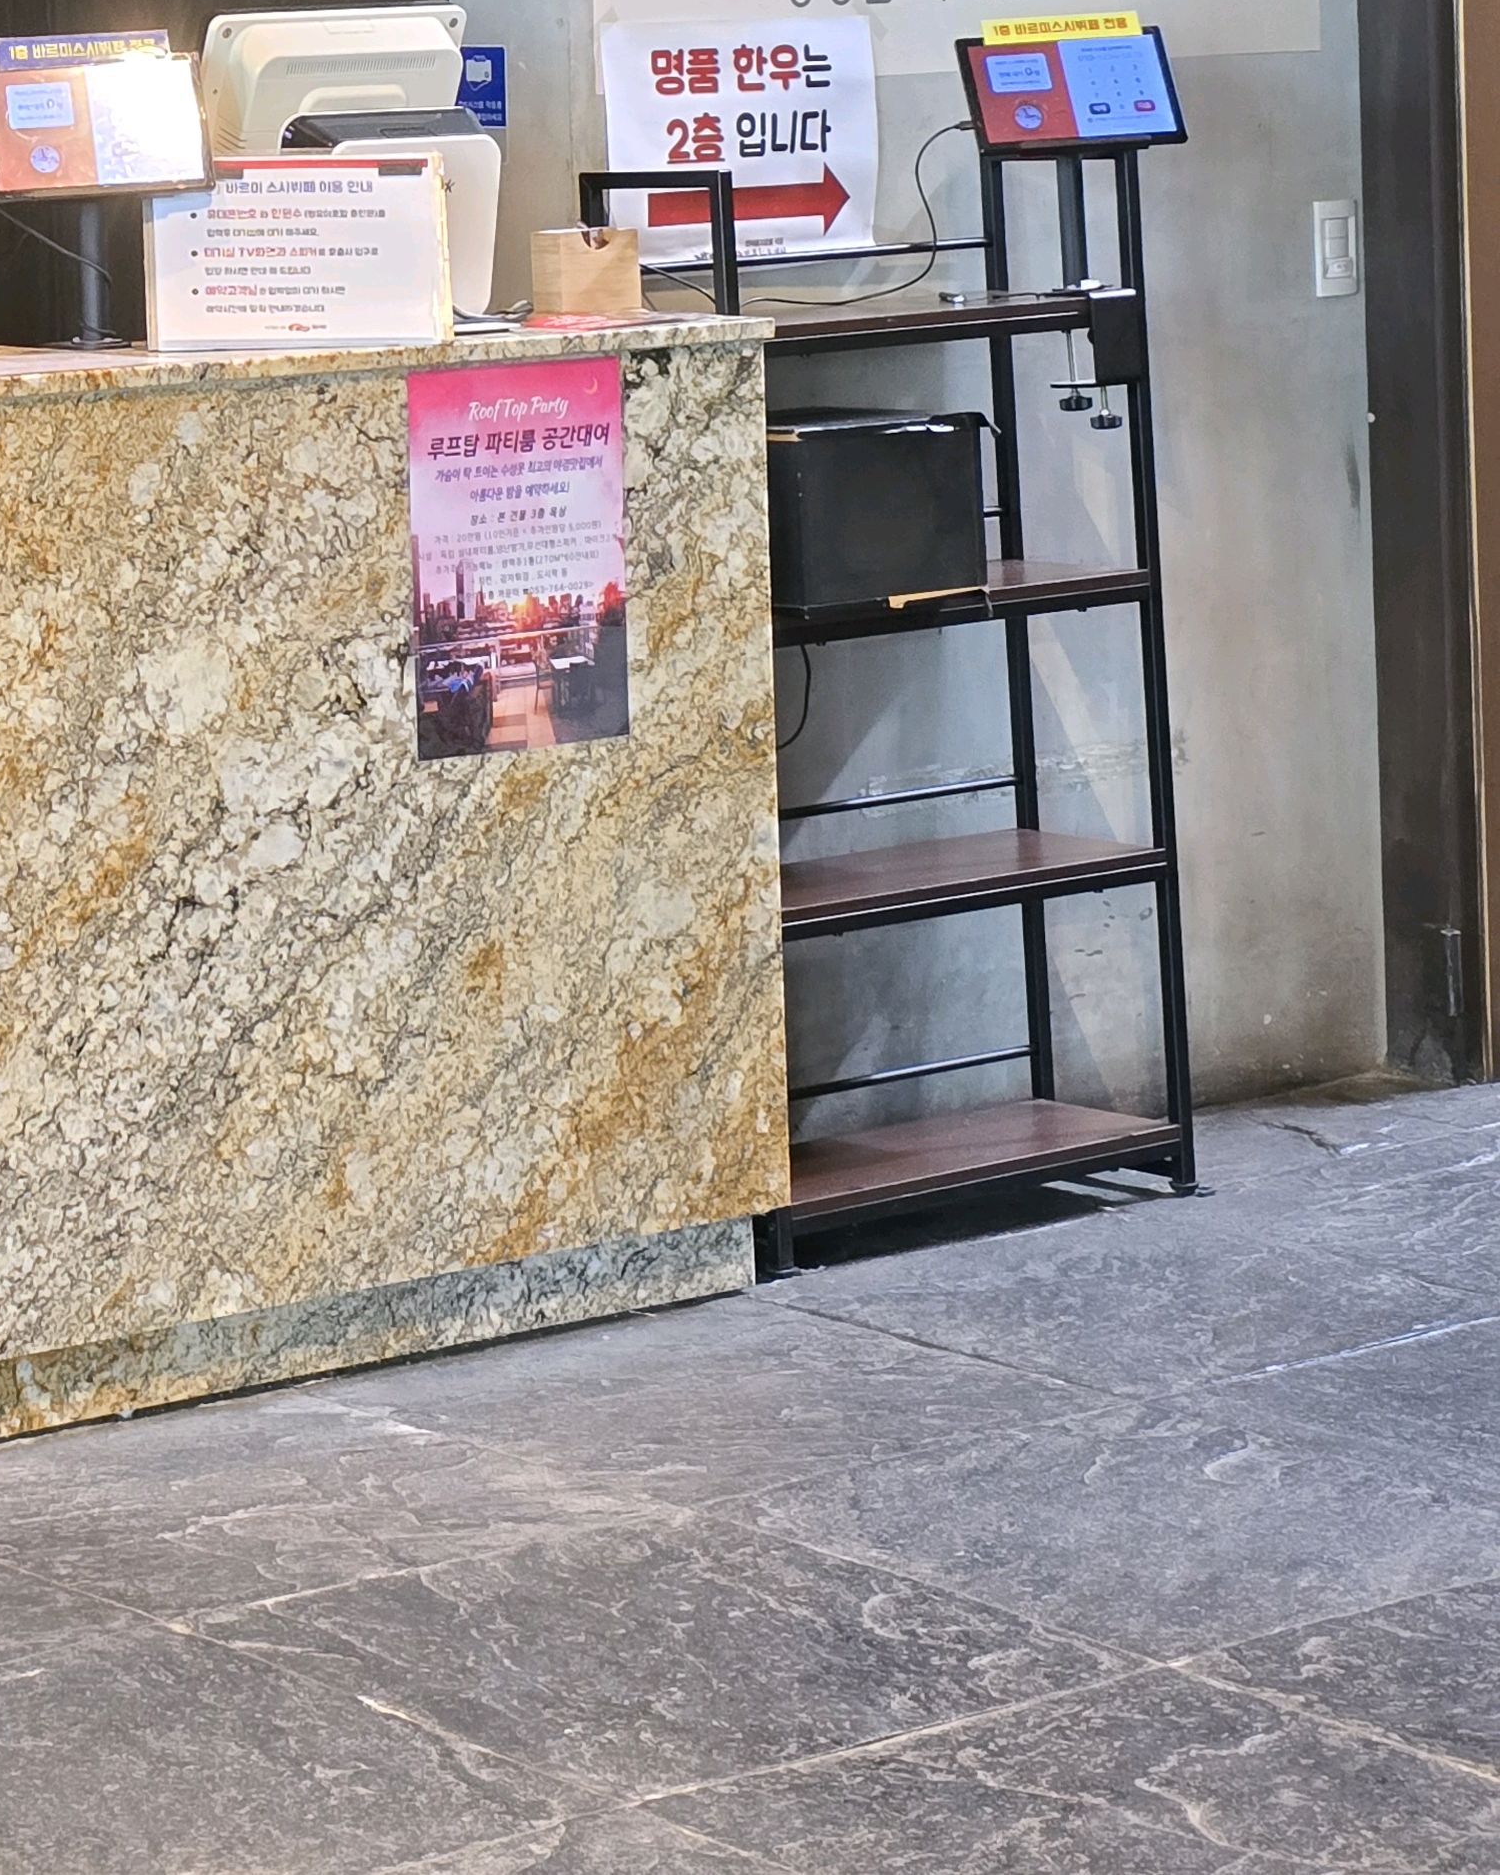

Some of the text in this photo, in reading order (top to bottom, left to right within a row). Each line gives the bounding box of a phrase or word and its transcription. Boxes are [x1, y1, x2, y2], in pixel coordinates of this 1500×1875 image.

[993, 25, 1010, 36] 1층
[651, 44, 832, 96] 명품 한우는
[666, 109, 831, 164] 2층 입니다
[226, 181, 372, 194] 바르미 스시뷔페 이용 안내
[469, 396, 568, 422] Roof Top Party
[428, 423, 610, 460] 루프탑 파티룸 공간대여
